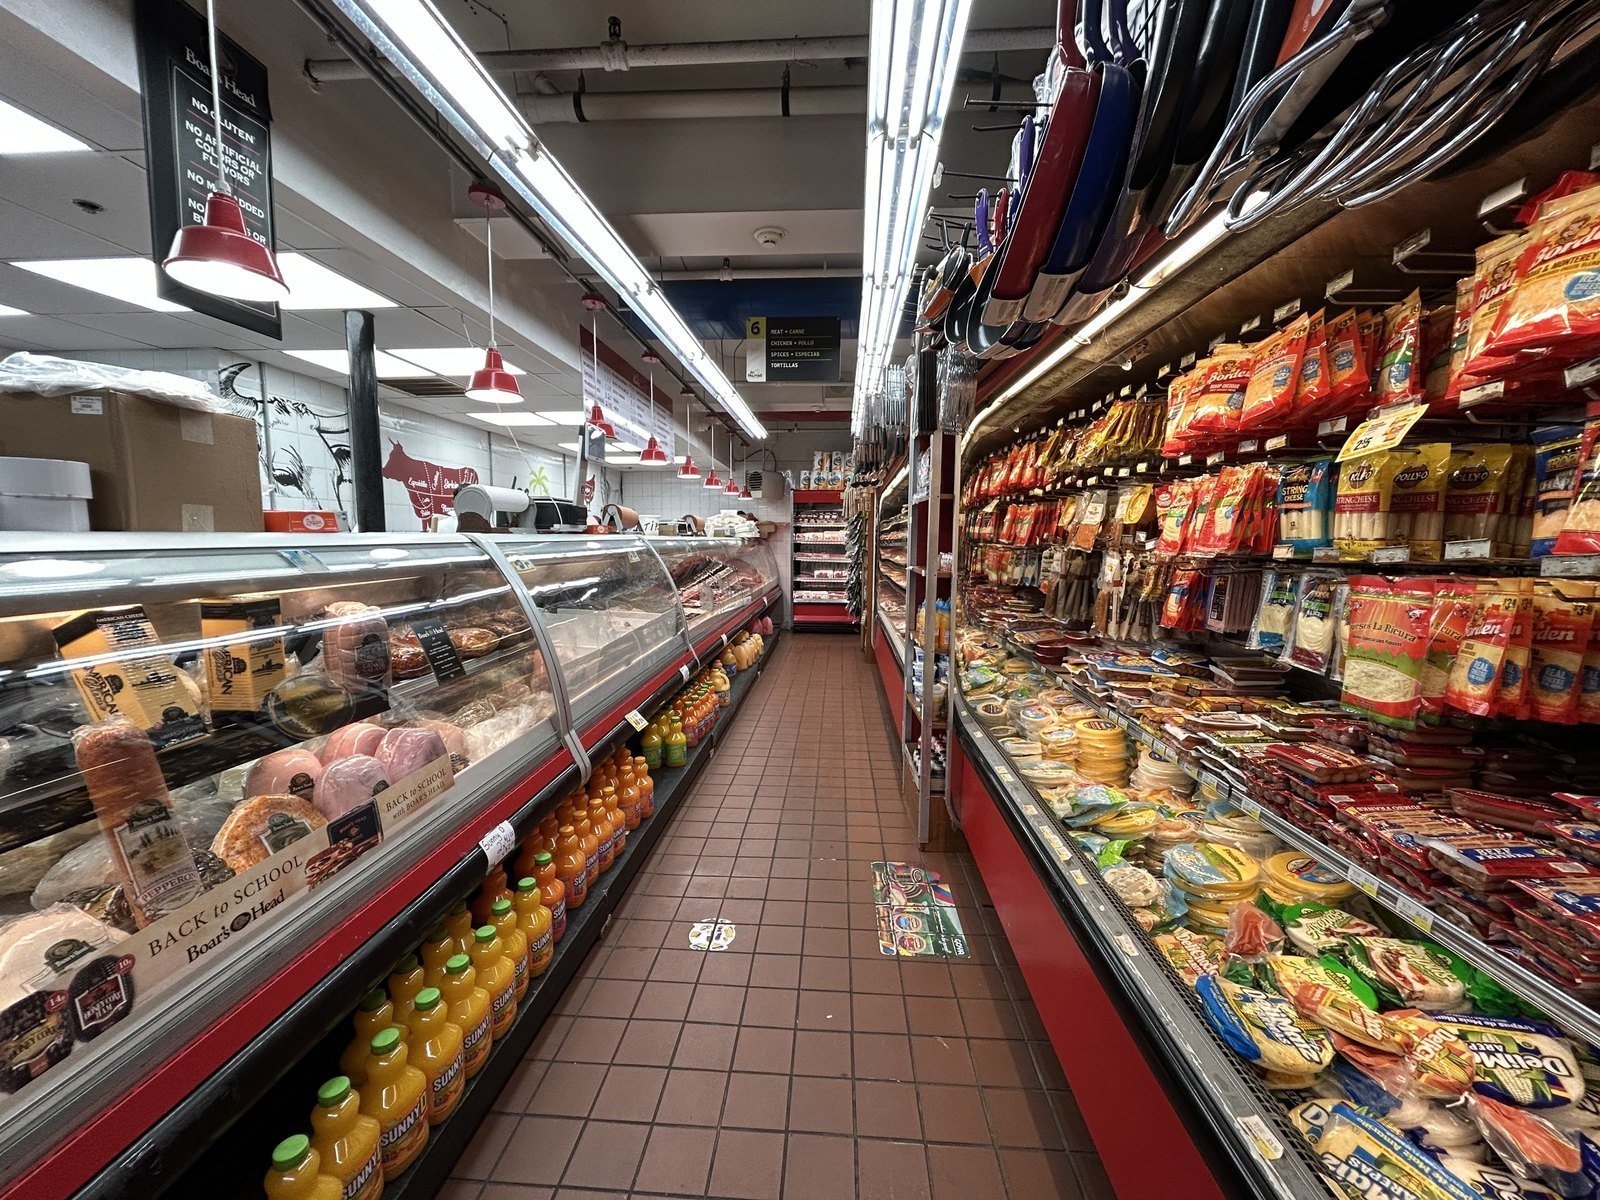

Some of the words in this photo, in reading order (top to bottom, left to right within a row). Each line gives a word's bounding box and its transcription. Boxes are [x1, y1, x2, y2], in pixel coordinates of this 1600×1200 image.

[224, 75, 257, 108] Head
[191, 97, 208, 115] NO
[185, 120, 202, 137] NO
[187, 169, 204, 186] NO
[240, 166, 255, 180] OR
[188, 198, 205, 213] NO
[252, 231, 267, 245] OR
[1476, 270, 1518, 309] Bord
[751, 321, 760, 335] 6
[1281, 485, 1309, 496] STRING
[1284, 494, 1303, 502] CHEESE
[1373, 621, 1382, 631] La
[1384, 623, 1417, 643] Ricura
[1466, 622, 1501, 637] orden
[385, 794, 408, 813] BACK
[409, 787, 417, 798] to
[418, 768, 447, 795] SCHOOL
[392, 807, 405, 820] with
[428, 781, 445, 799] HEAD
[482, 833, 502, 850] Sunny
[1474, 847, 1511, 856] BEEF
[148, 911, 209, 958] BACK
[213, 901, 229, 918] to
[233, 854, 304, 905] SCHOOL
[185, 925, 231, 964] Boar's
[250, 888, 286, 924] Head
[1467, 1042, 1504, 1052] AREP
[1348, 1154, 1420, 1200] AREPAS
